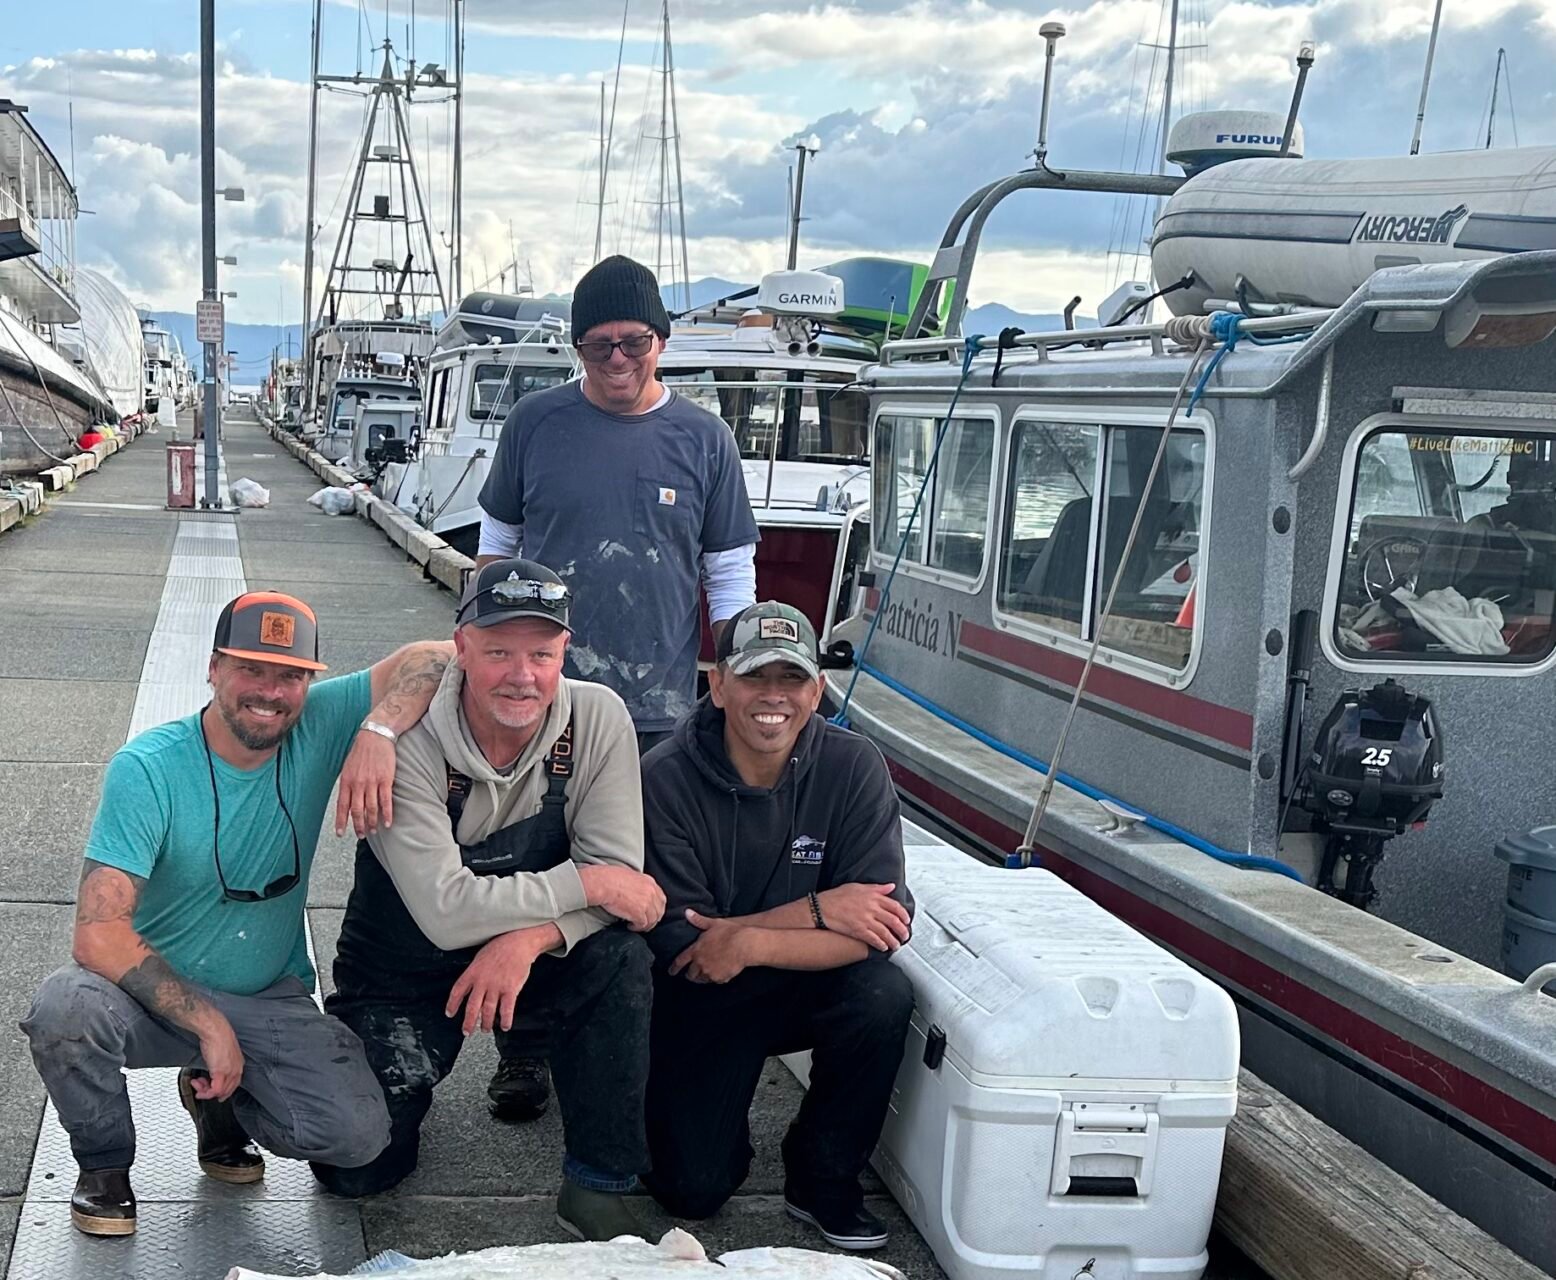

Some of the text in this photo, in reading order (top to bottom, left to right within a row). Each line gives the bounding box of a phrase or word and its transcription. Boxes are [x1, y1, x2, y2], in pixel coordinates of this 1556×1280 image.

[1357, 212, 1457, 243] MERCURY
[778, 293, 837, 307] GARMIN
[877, 591, 962, 661] Patricia N
[1361, 747, 1393, 766] 2.5
